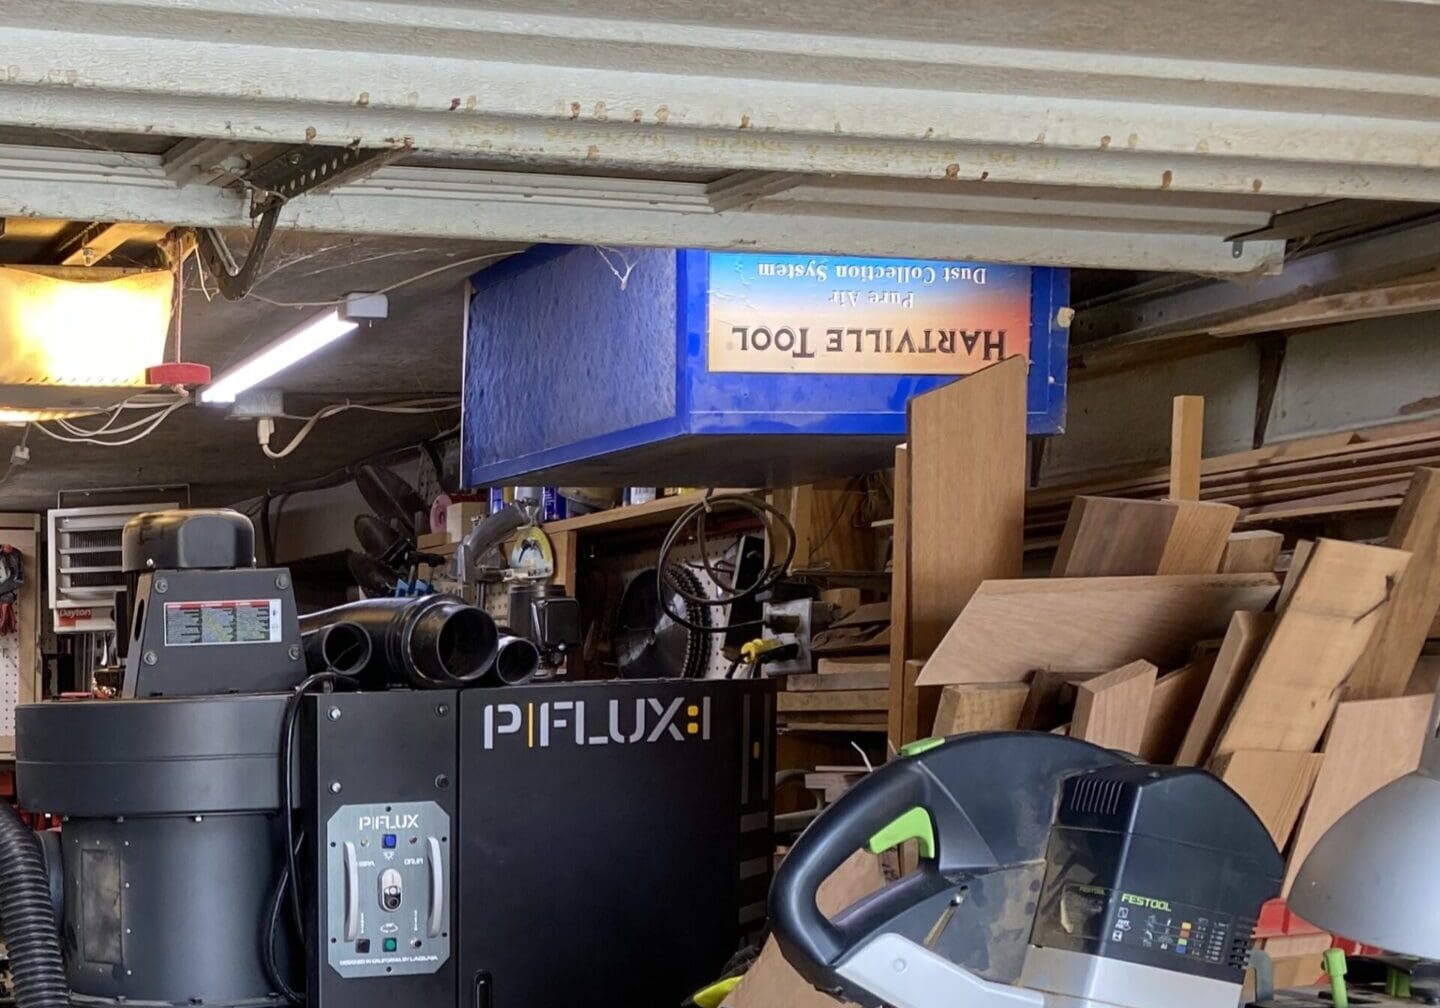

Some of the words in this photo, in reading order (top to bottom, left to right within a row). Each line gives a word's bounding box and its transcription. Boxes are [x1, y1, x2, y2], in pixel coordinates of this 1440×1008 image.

[757, 262, 828, 284] System
[835, 265, 936, 284] Collection
[943, 266, 987, 285] Dust
[829, 290, 858, 308] Air
[867, 292, 915, 309] Pure
[60, 608, 91, 619] Dayton
[1121, 892, 1172, 913] FESTOOL
